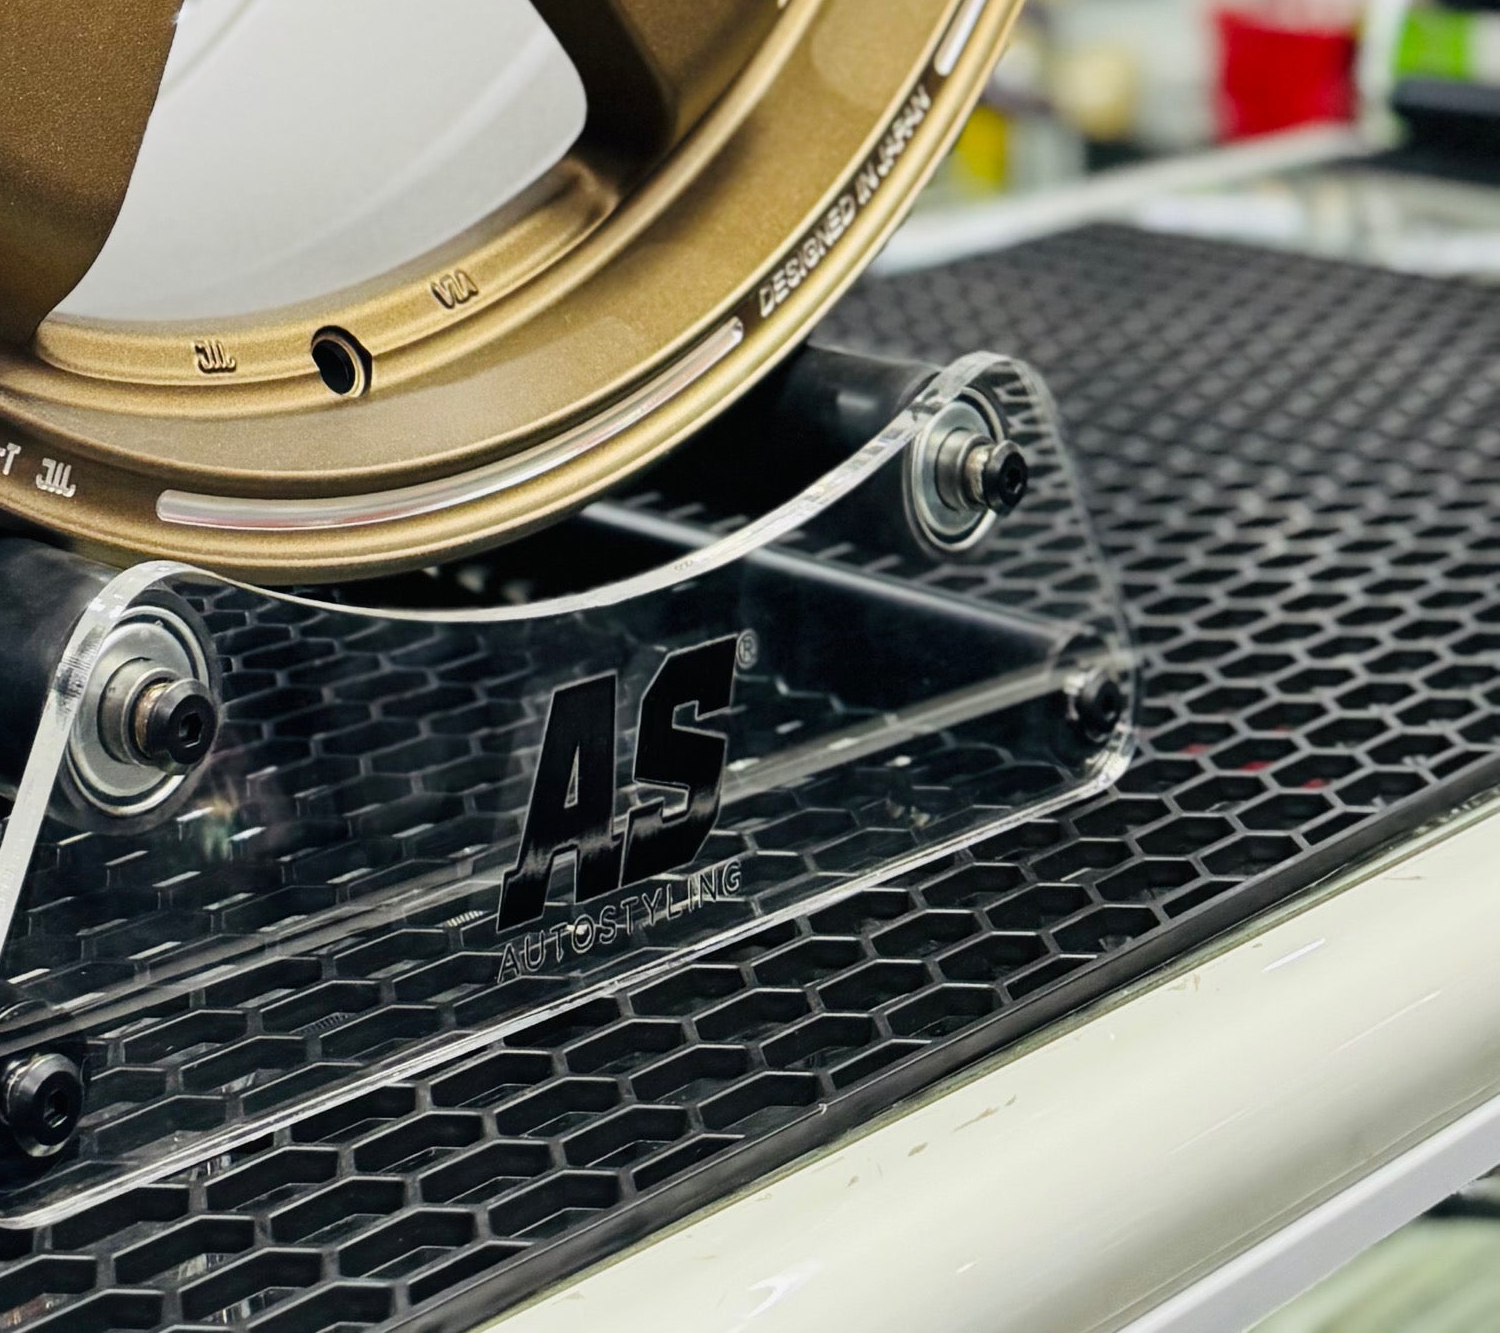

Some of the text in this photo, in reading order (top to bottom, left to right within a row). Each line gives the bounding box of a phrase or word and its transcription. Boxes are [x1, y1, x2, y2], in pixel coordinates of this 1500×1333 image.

[759, 83, 932, 317] DESIGNED IN JAPAN
[496, 860, 744, 982] AUTOSTYLING
